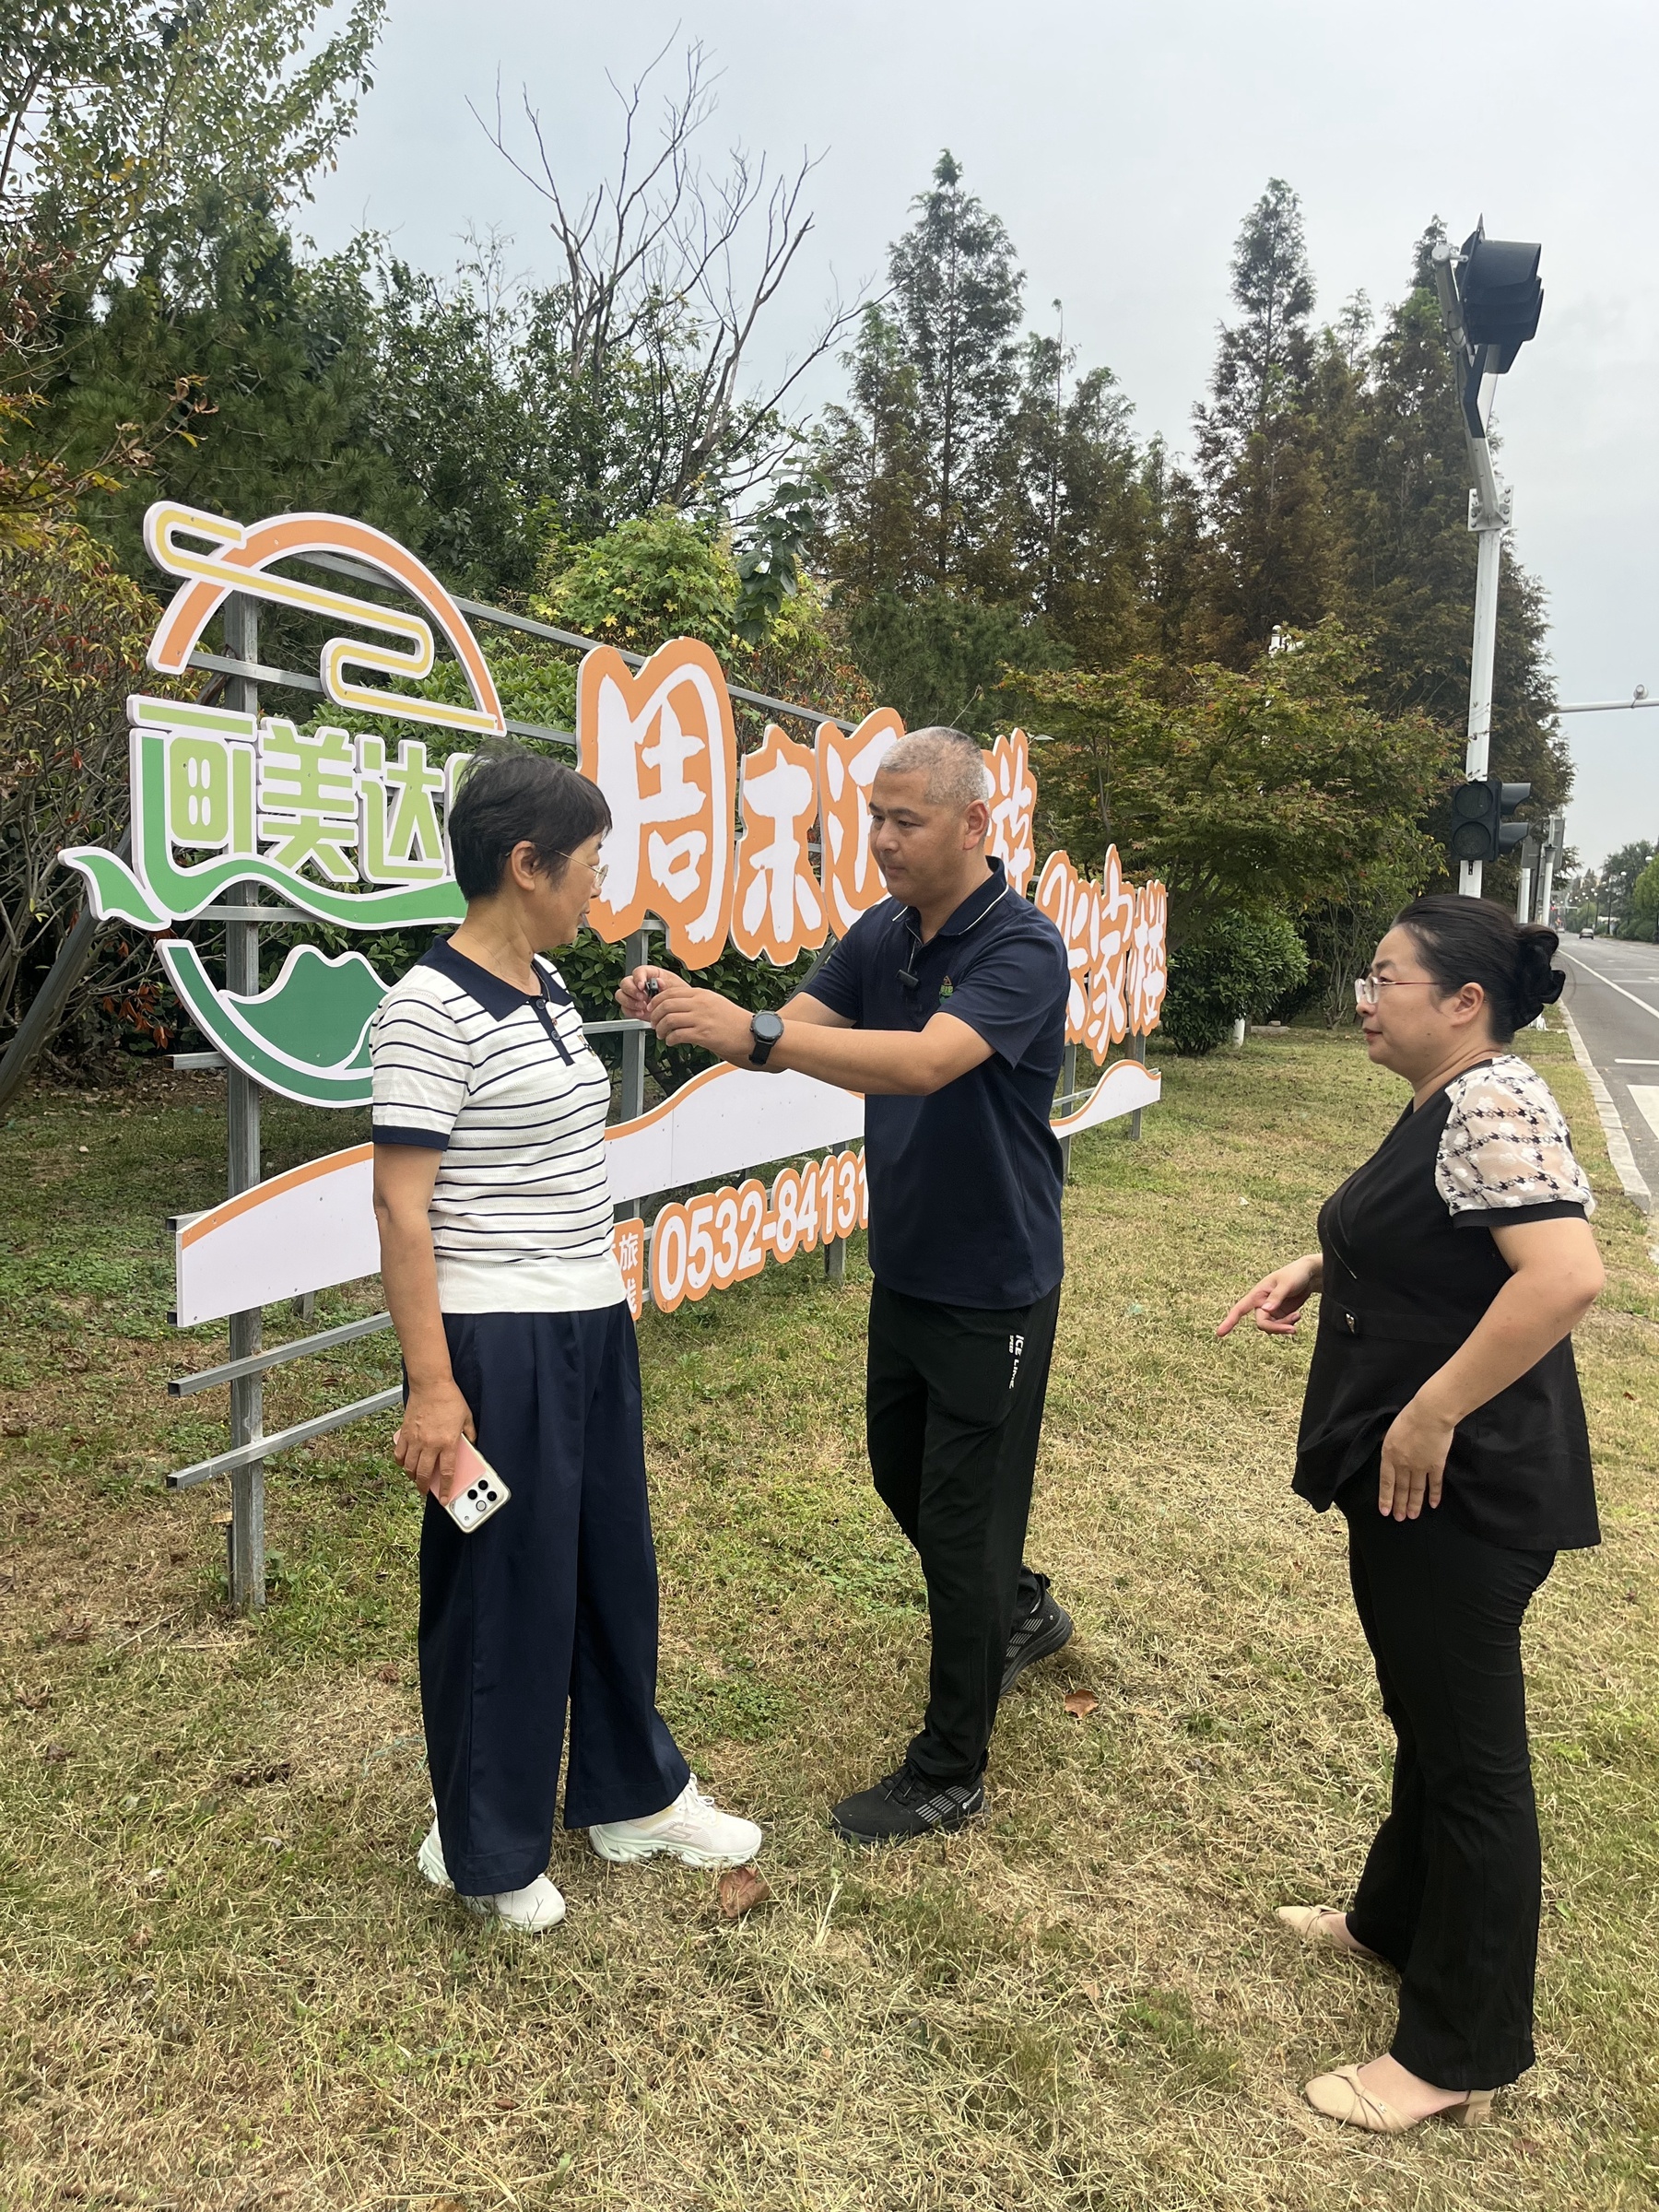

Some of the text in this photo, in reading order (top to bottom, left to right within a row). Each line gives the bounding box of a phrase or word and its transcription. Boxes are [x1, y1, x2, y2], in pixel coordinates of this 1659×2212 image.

[131, 699, 476, 883] 画美达
[1015, 1334, 1025, 1356] ICE
